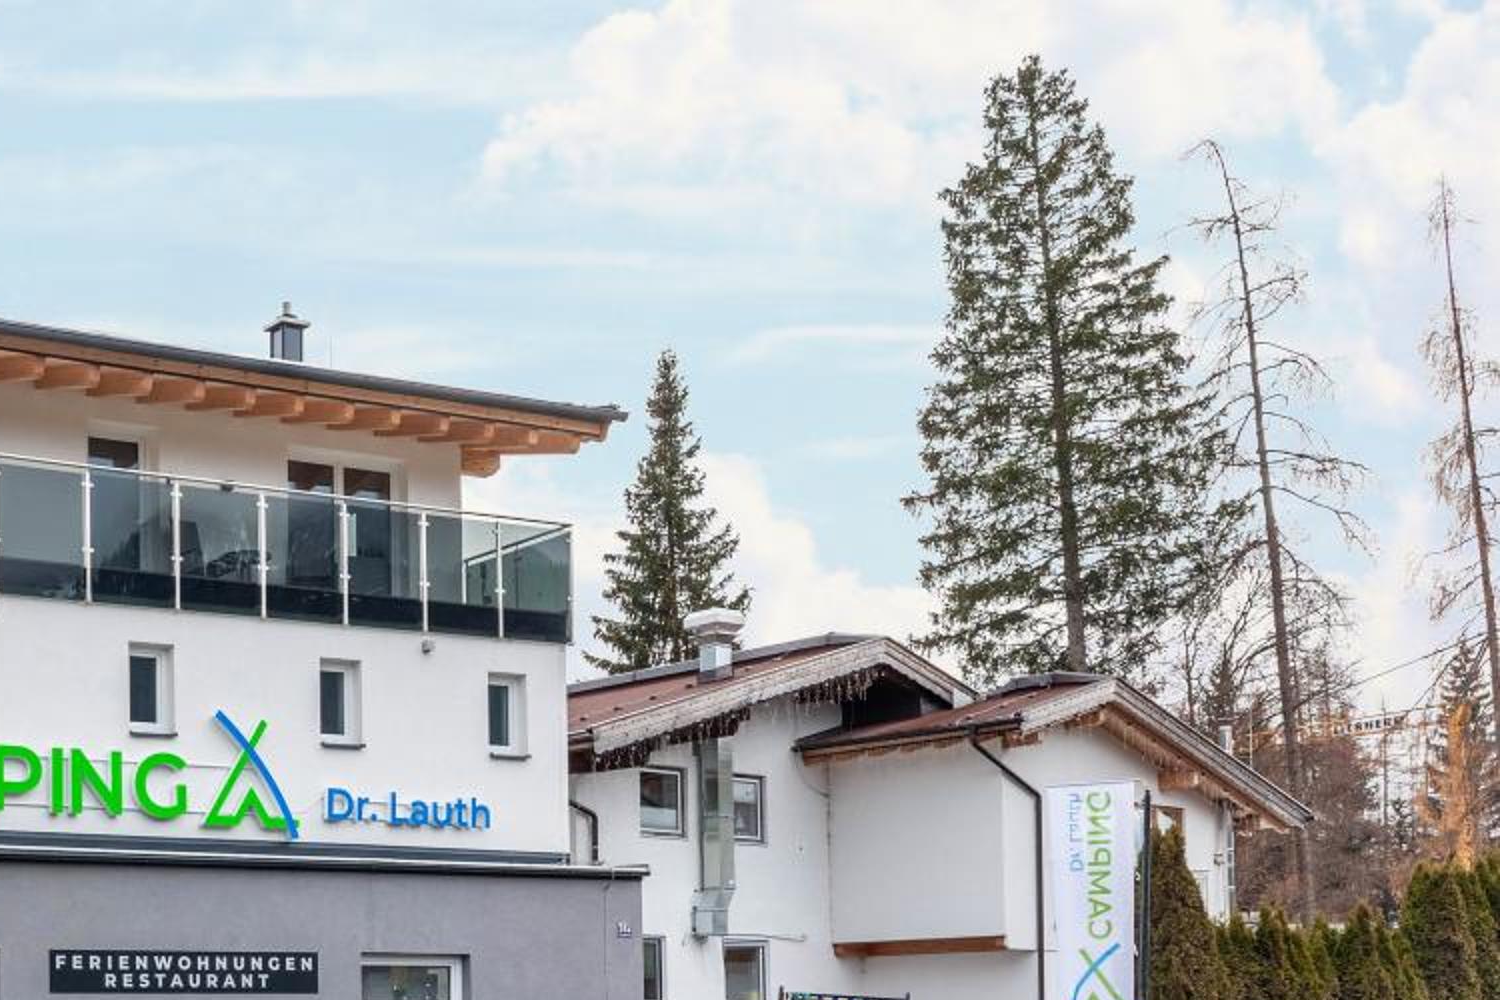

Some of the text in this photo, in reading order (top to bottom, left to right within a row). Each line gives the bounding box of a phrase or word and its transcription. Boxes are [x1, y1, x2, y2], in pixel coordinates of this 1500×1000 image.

[326, 787, 491, 829] Dr. Lauth
[54, 954, 314, 972] FERIENWOHNUNGEN
[104, 973, 270, 989] RESTAURANT
